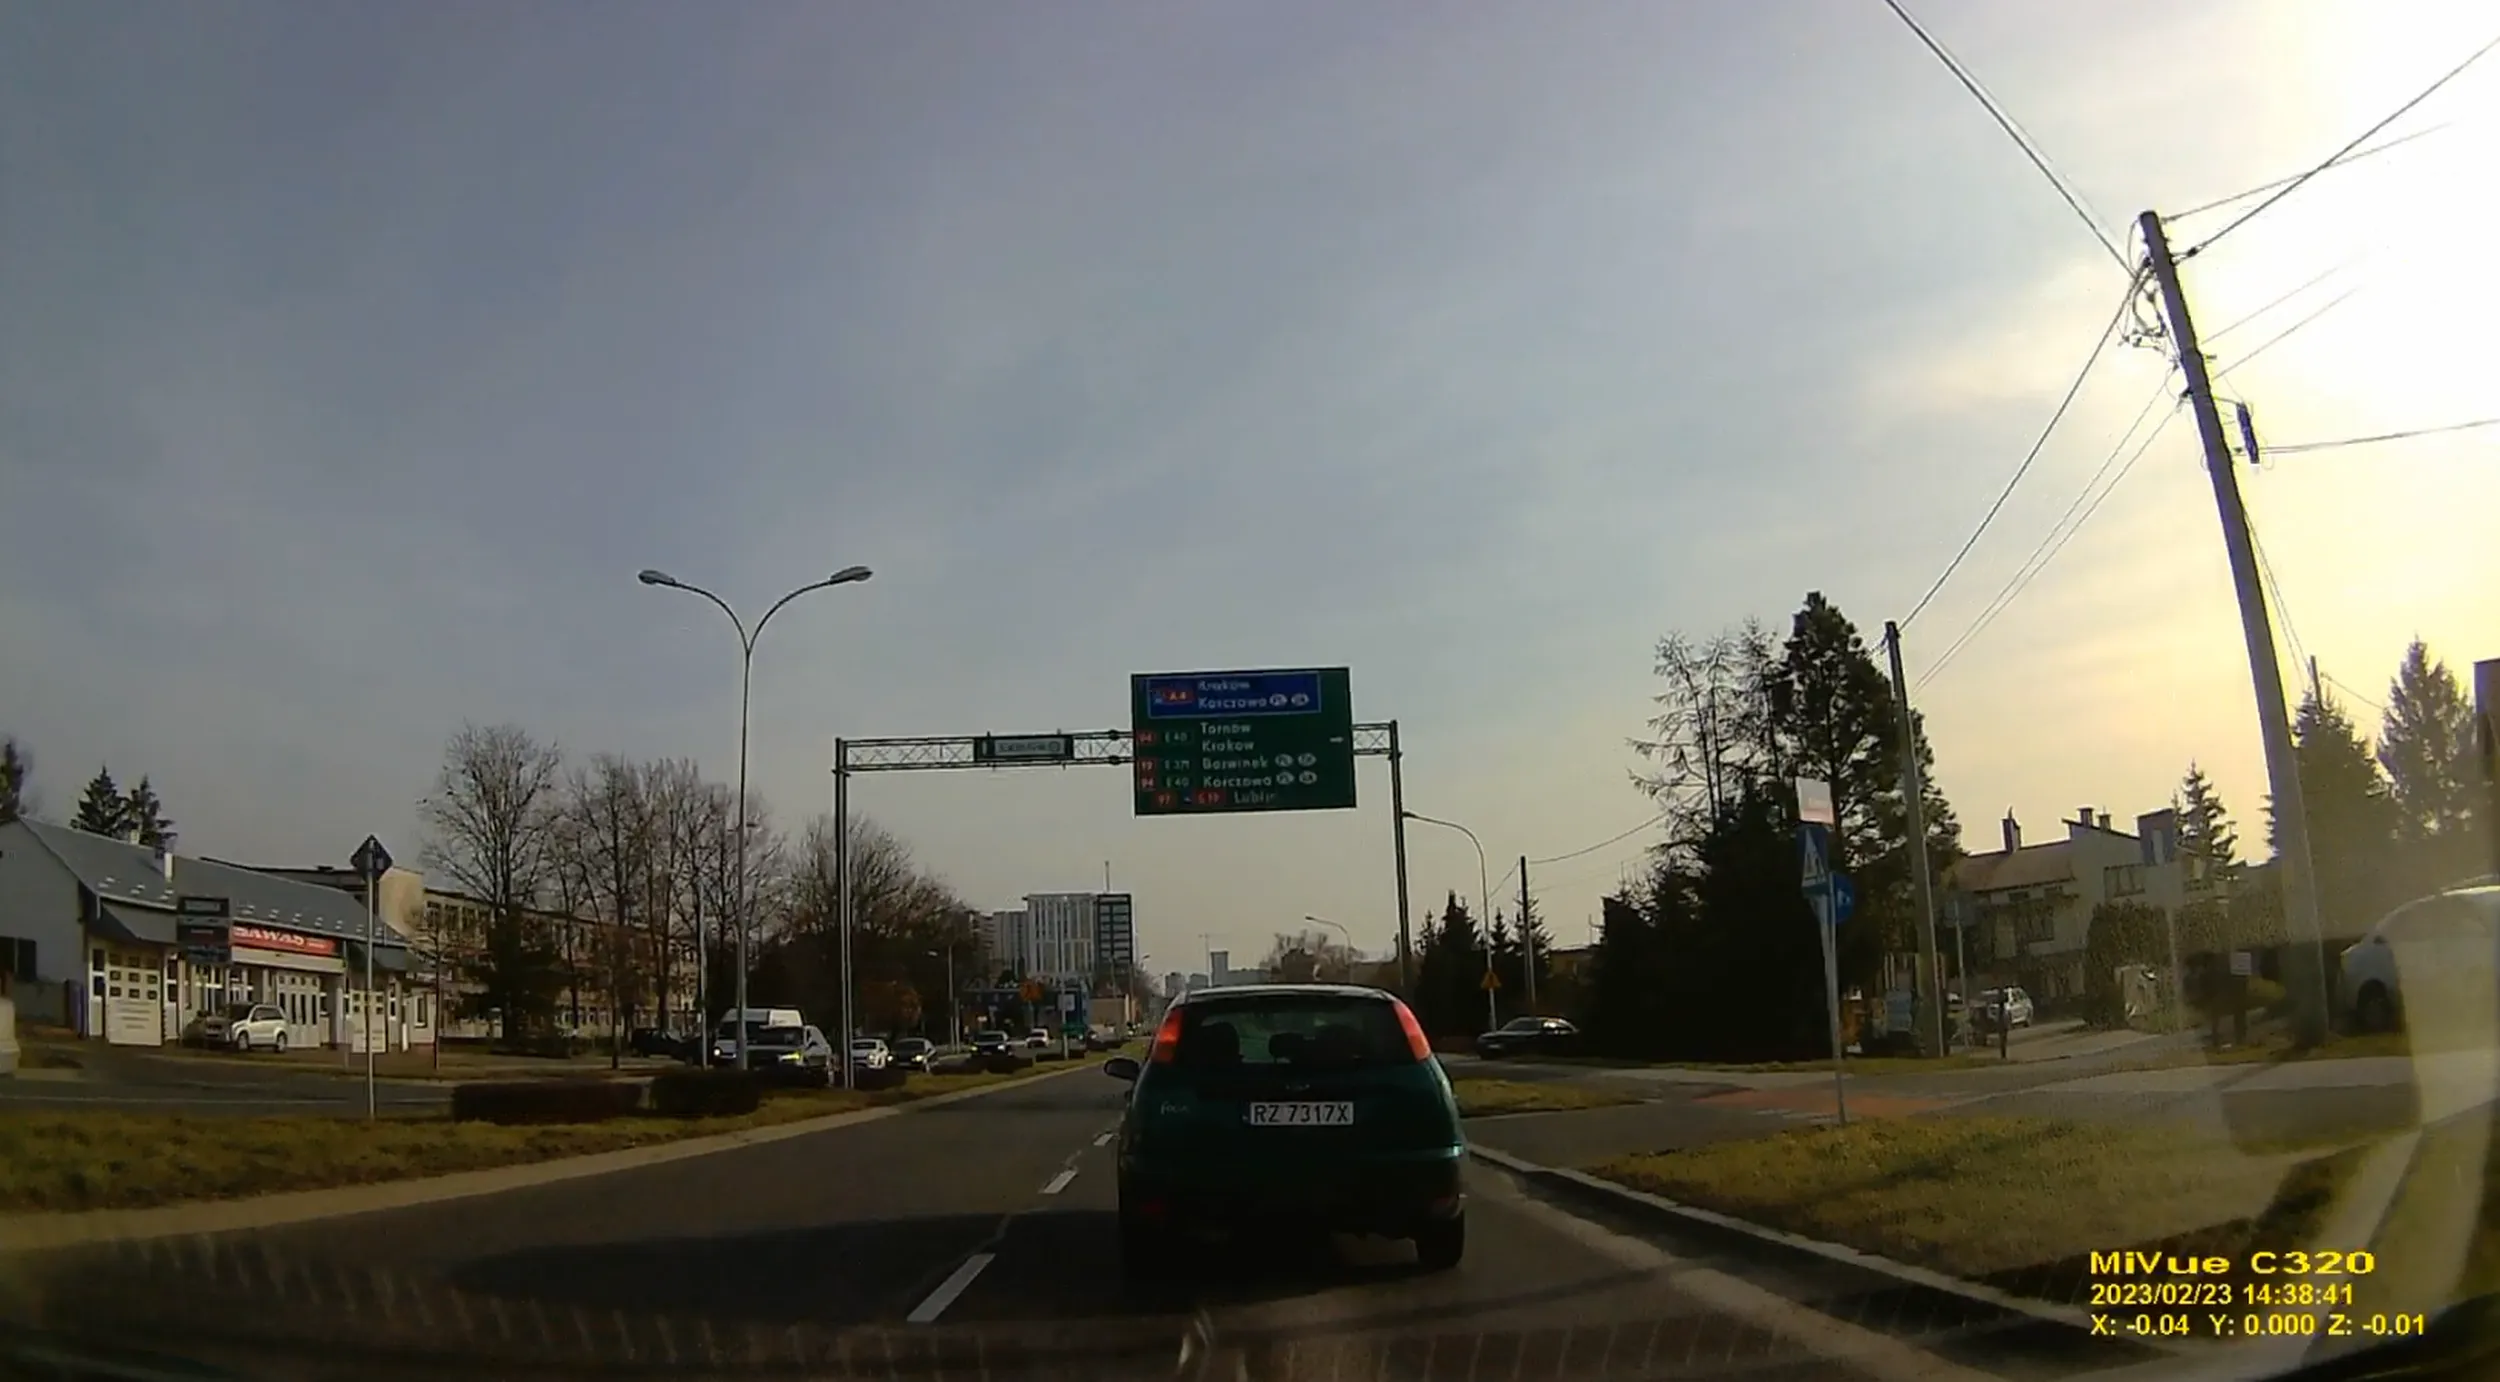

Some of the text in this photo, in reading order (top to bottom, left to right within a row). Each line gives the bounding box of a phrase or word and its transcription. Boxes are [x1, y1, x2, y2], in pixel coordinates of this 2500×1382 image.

[1203, 774, 1272, 788] Korczowa
[1254, 1104, 1349, 1123] RZ 7317X
